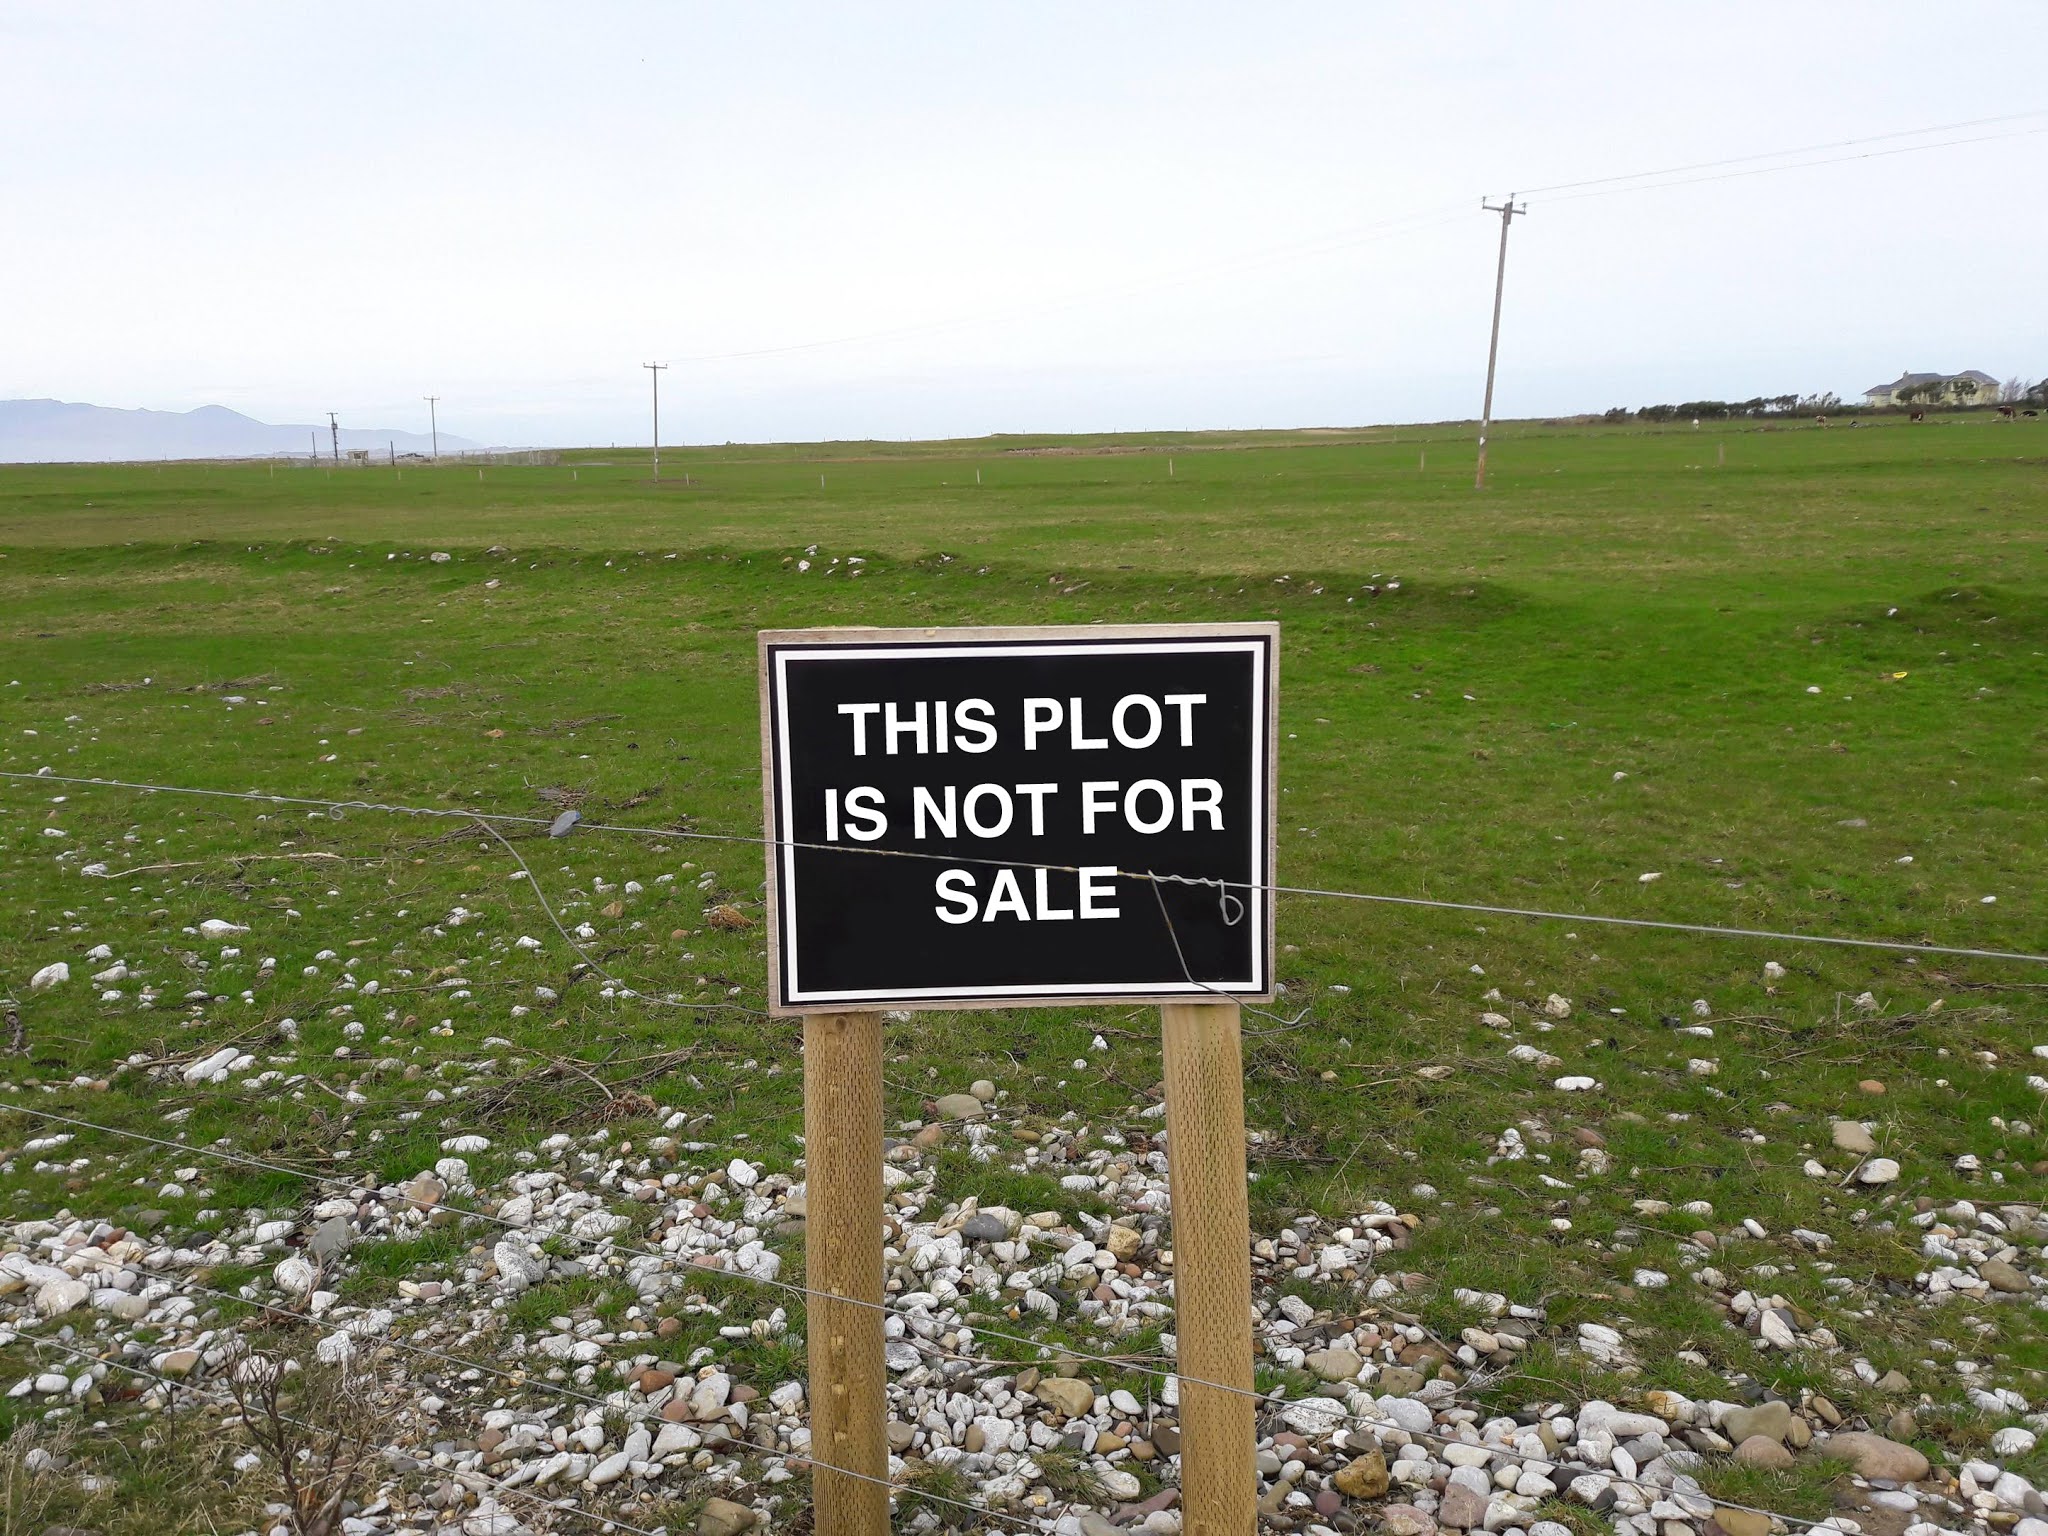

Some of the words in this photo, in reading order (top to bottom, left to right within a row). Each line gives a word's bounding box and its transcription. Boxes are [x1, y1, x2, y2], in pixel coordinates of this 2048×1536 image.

[837, 698, 998, 756] THIS
[1023, 693, 1207, 751] PLOT
[825, 786, 888, 842] IS
[913, 782, 1058, 840] NOT
[1081, 778, 1225, 835] FOR
[935, 866, 1121, 925] SALE
